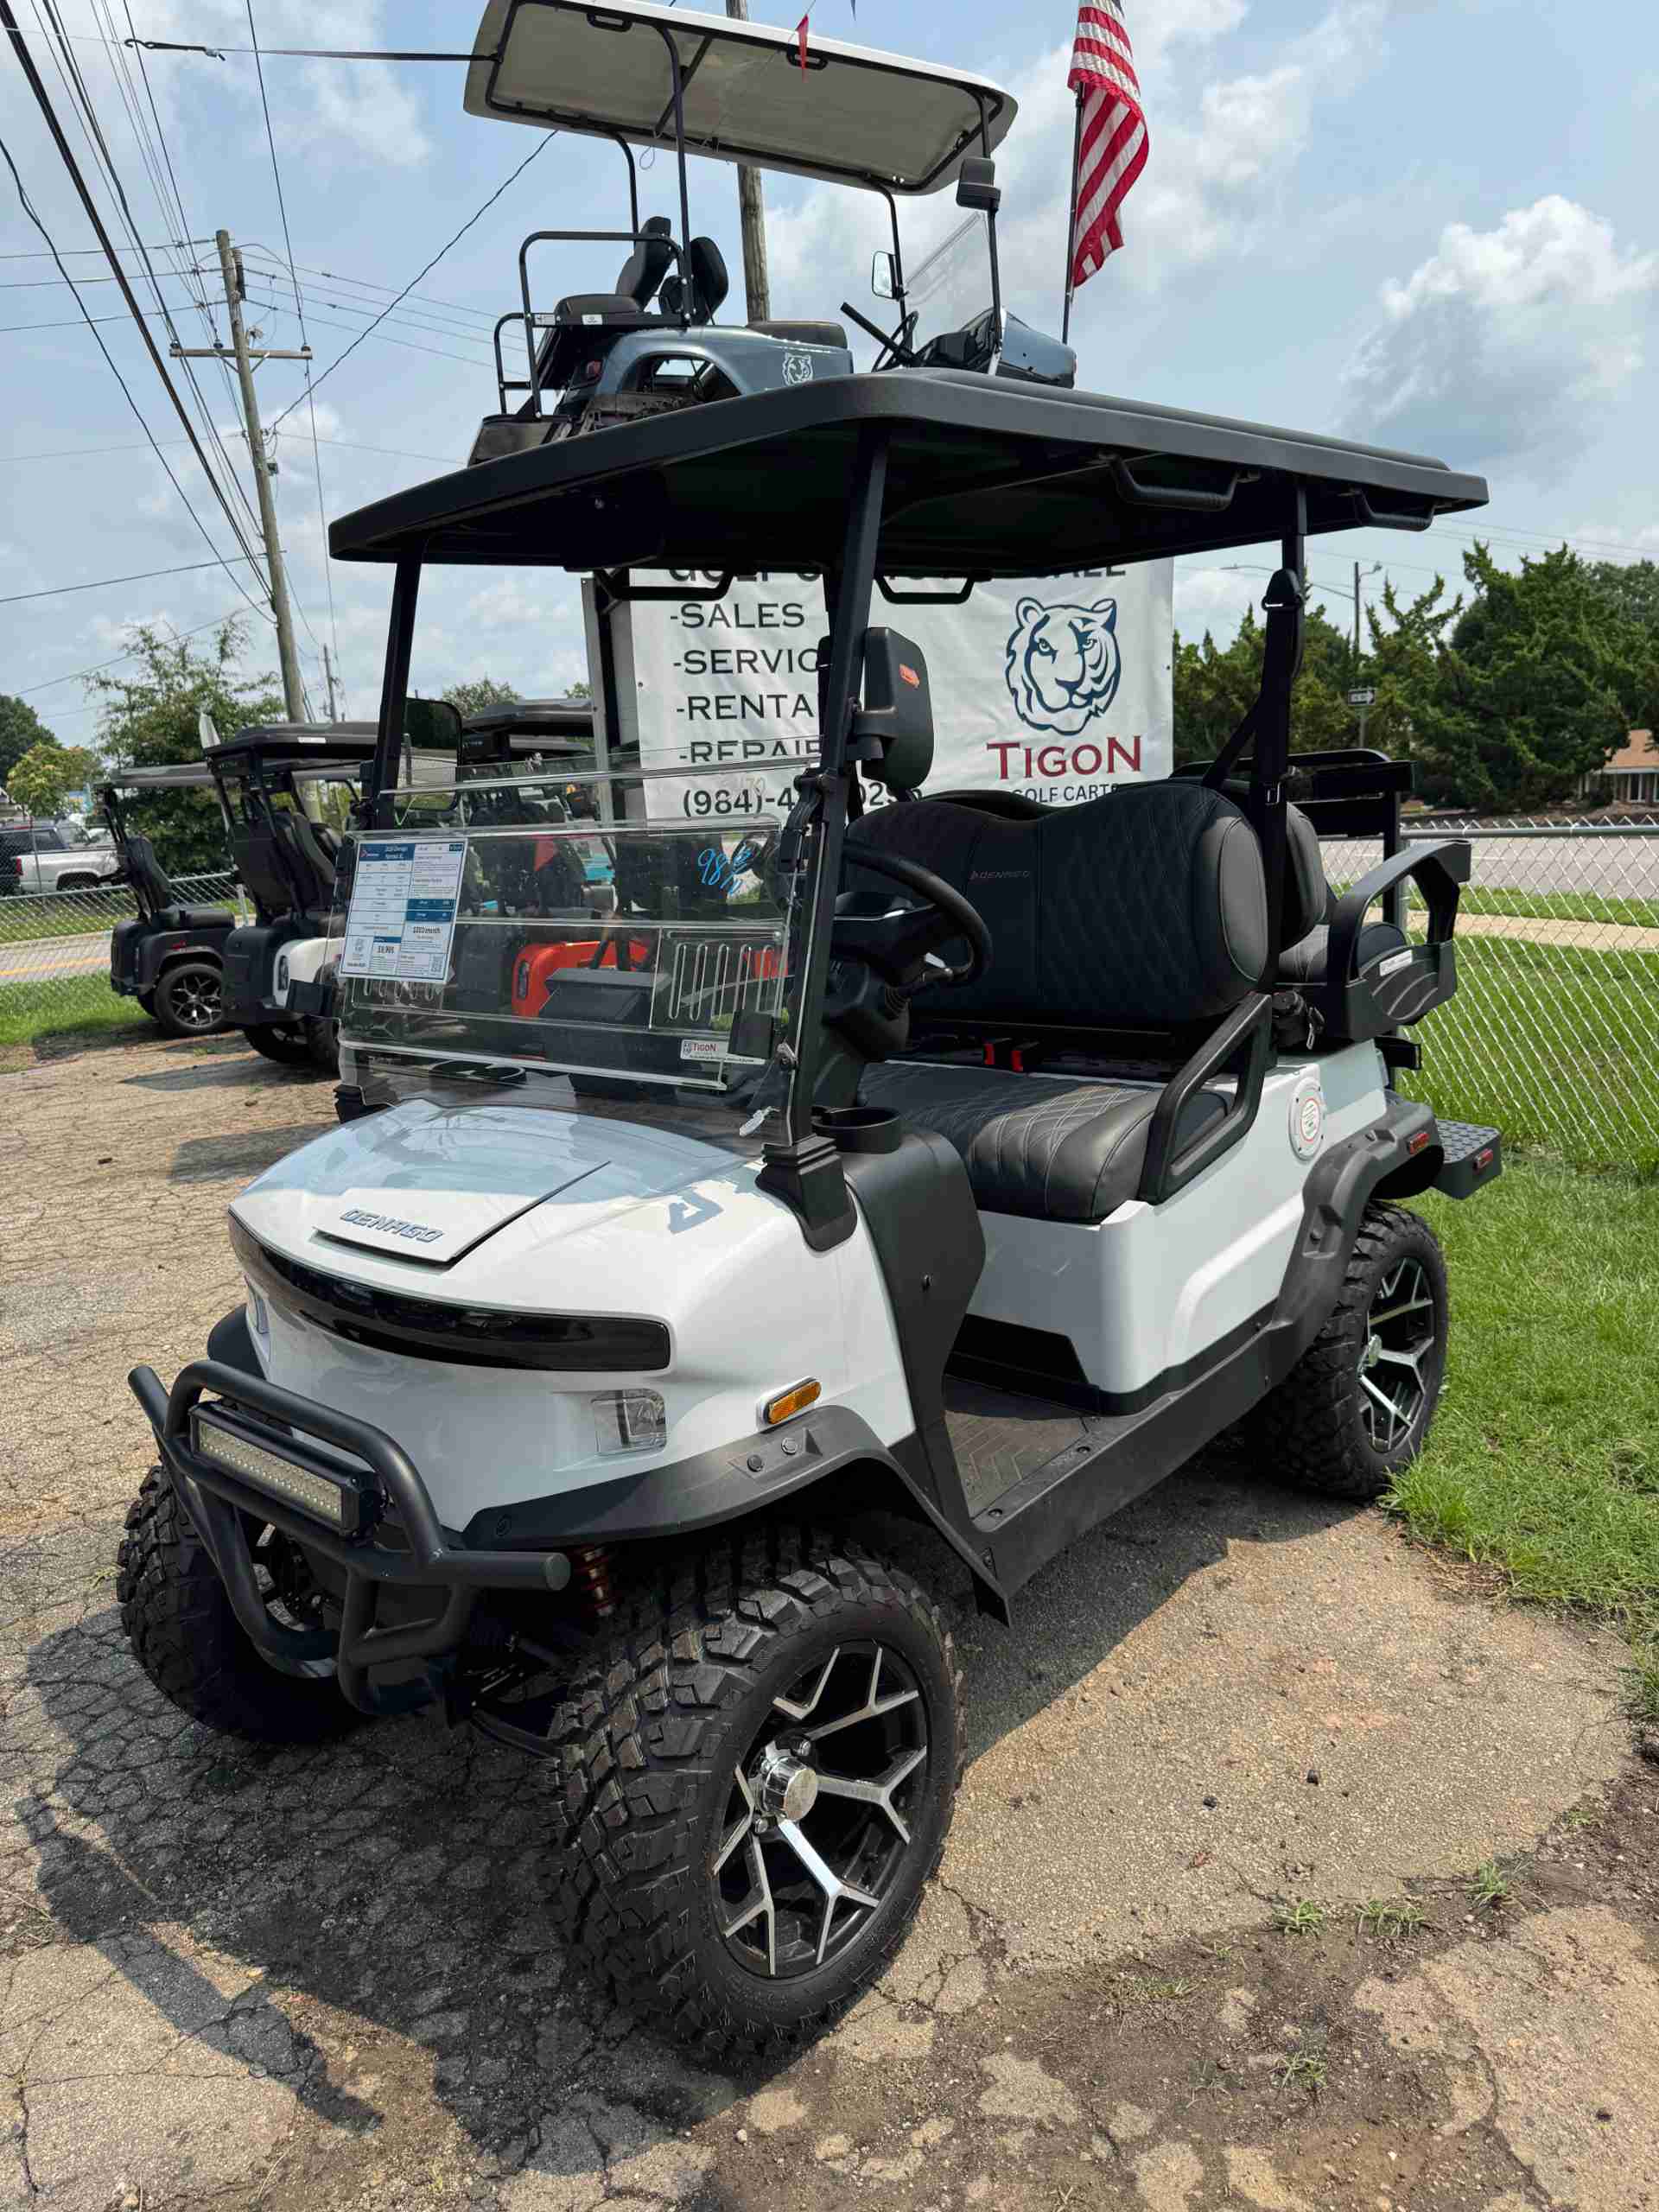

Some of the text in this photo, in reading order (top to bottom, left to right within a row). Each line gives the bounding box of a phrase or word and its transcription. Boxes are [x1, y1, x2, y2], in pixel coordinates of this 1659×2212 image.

[670, 602, 806, 629] -SALES
[986, 735, 1141, 780] TIGON
[1013, 786, 1058, 803] OLF
[340, 1208, 445, 1243] DENAGO
